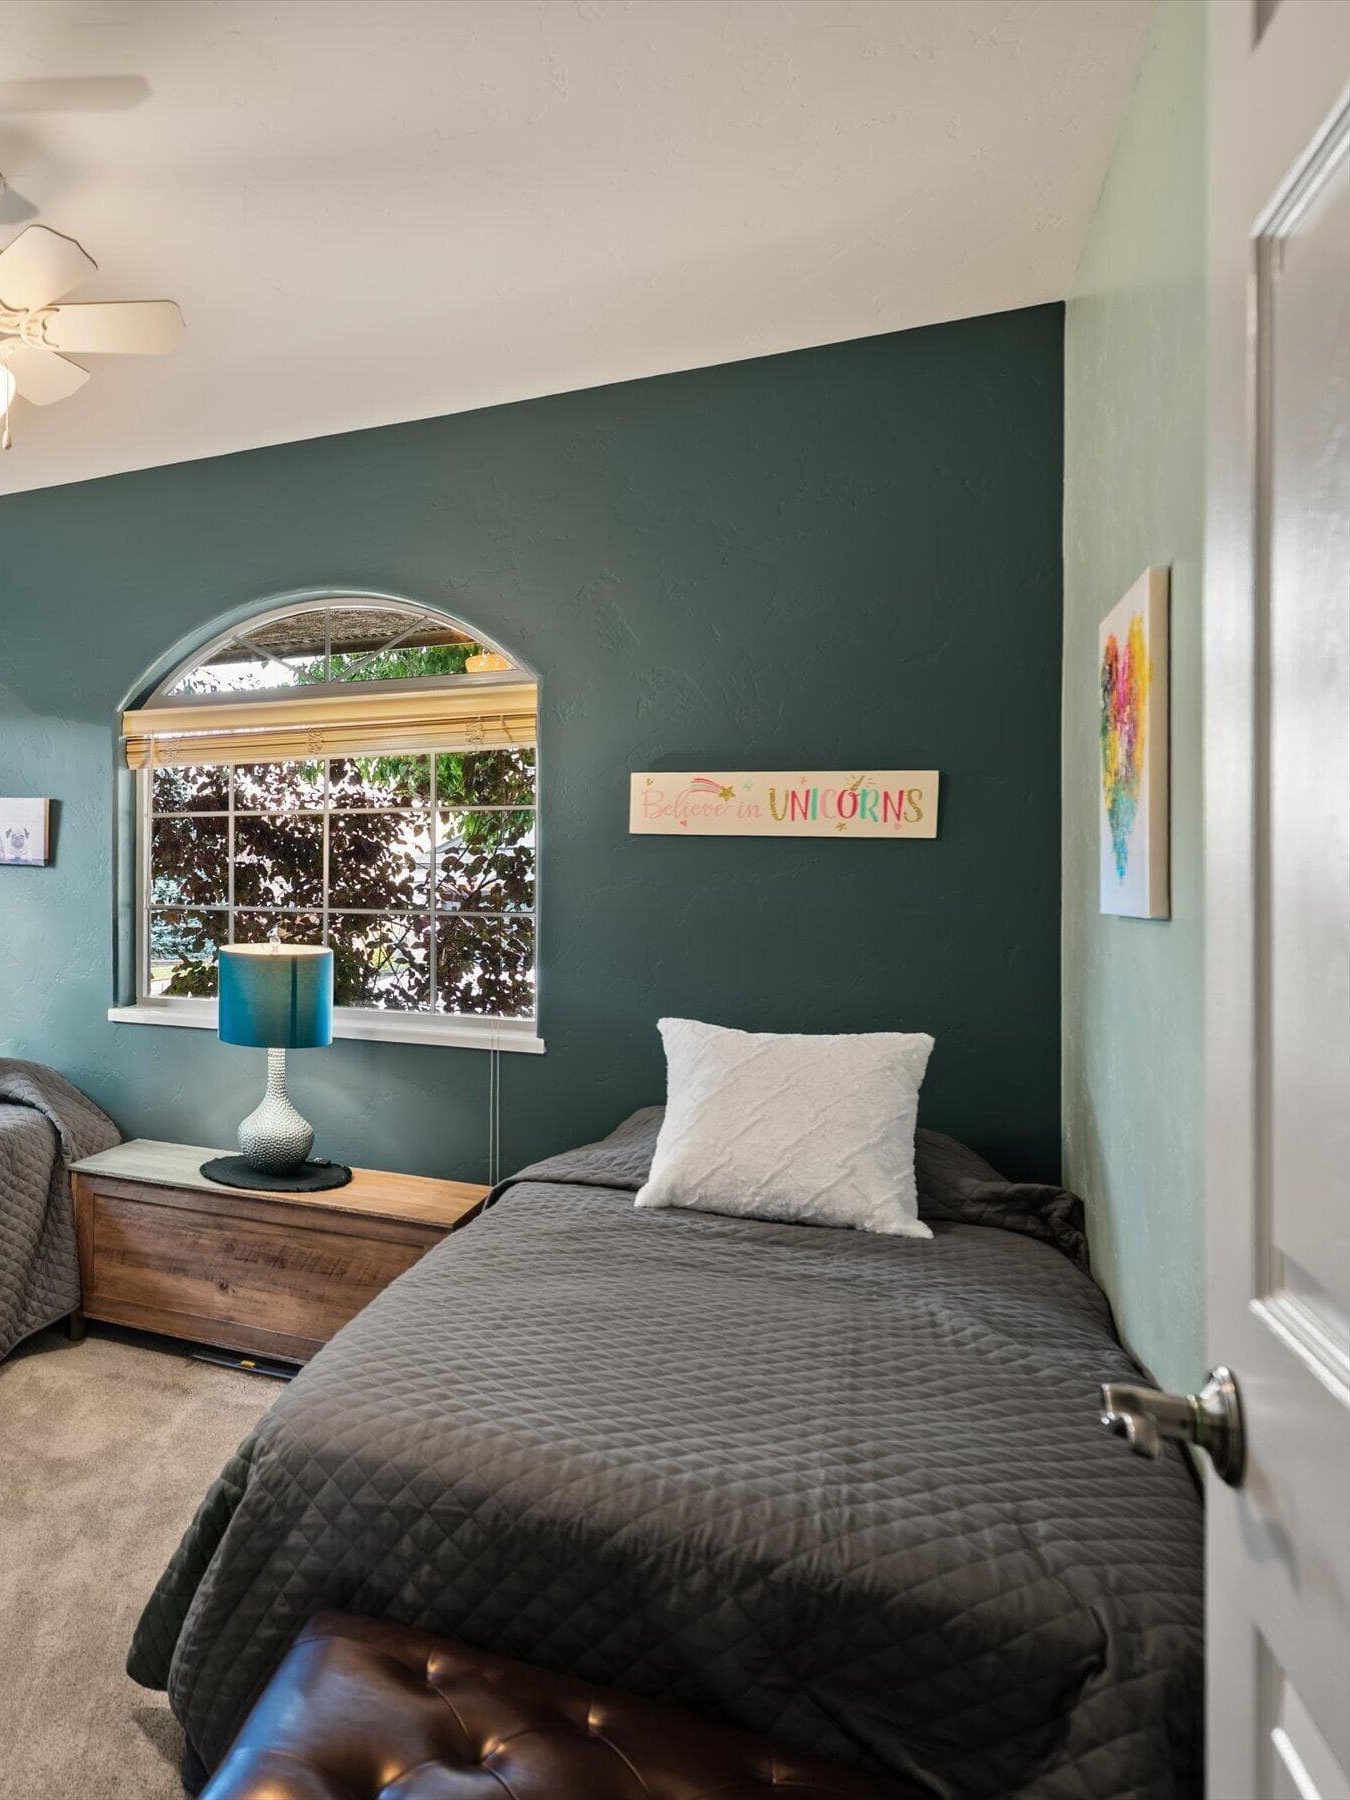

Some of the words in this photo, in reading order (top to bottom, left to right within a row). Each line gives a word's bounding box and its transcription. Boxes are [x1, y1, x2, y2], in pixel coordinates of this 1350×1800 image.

[640, 789, 733, 820] Believe
[738, 800, 762, 819] in
[768, 788, 924, 823] UNICORNS
